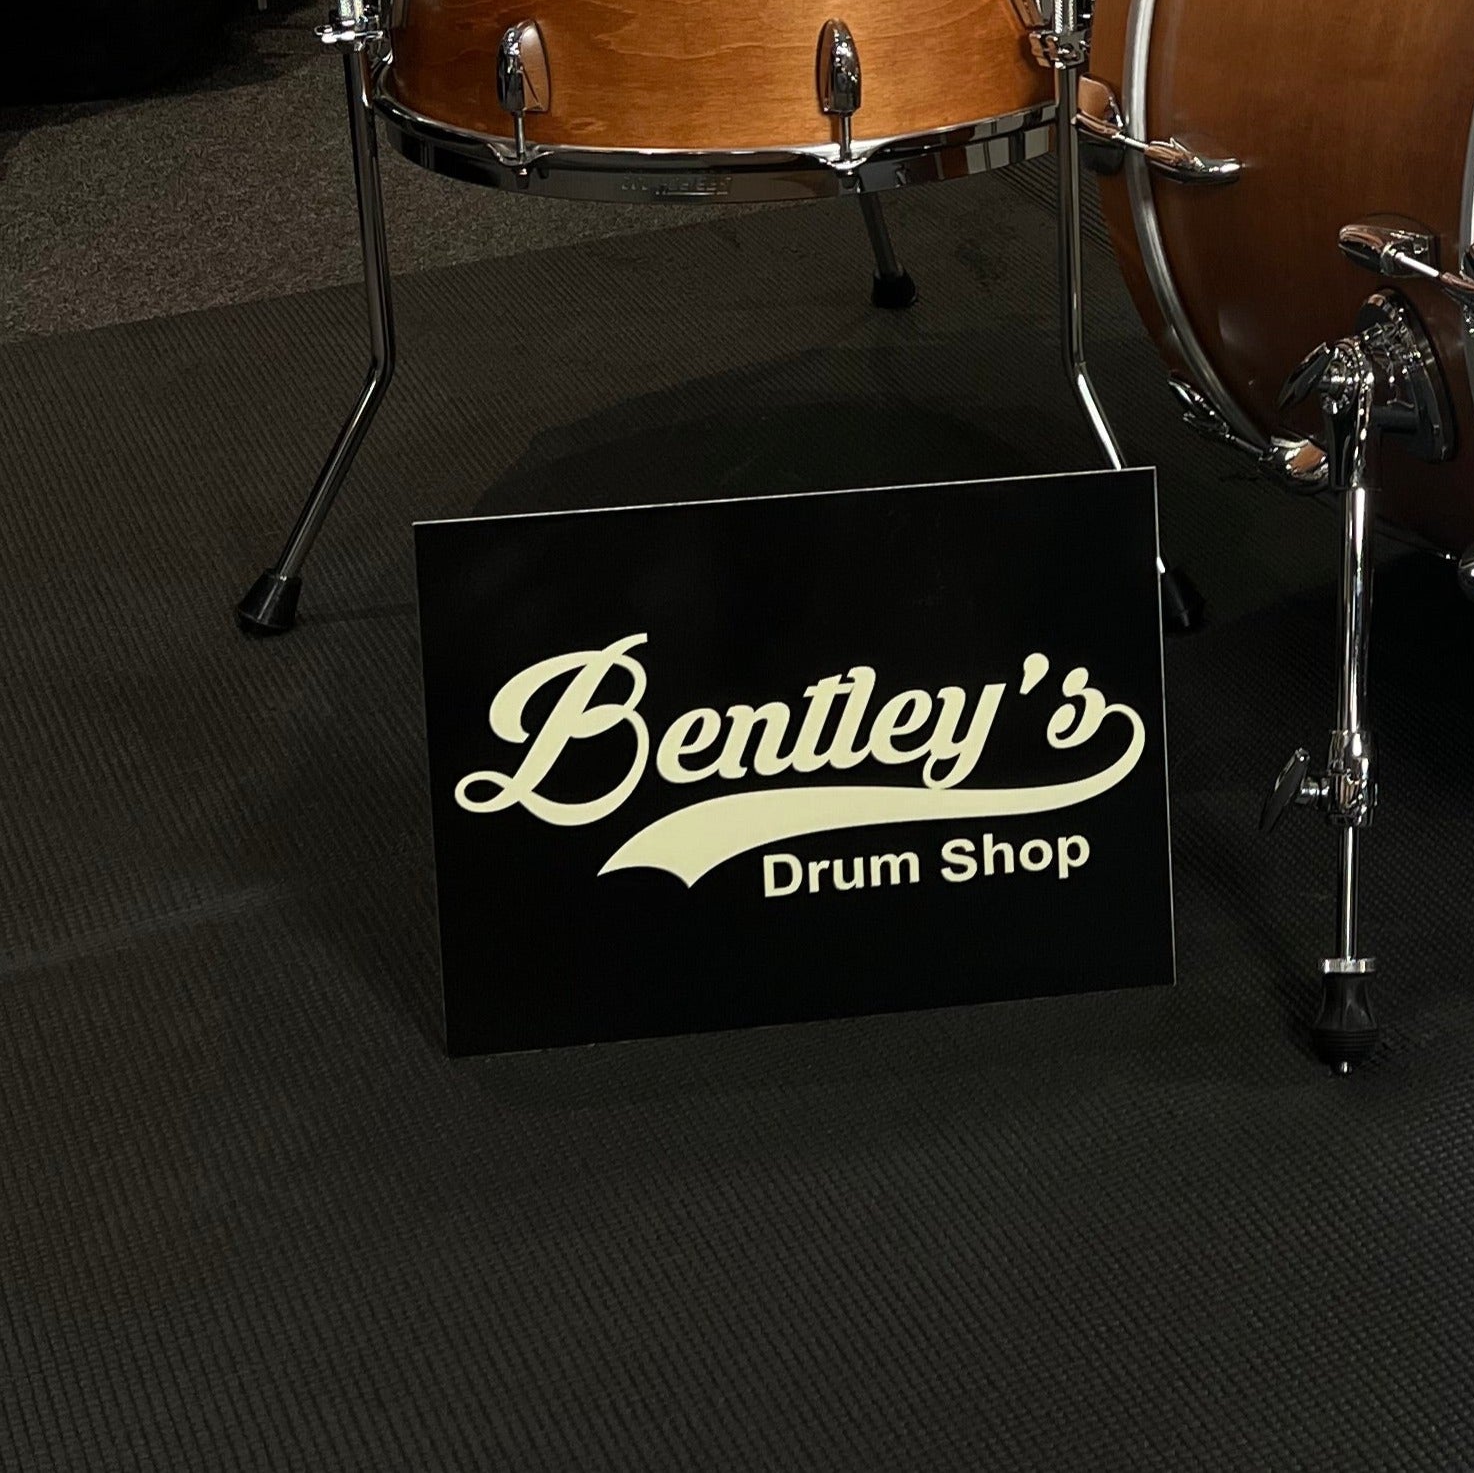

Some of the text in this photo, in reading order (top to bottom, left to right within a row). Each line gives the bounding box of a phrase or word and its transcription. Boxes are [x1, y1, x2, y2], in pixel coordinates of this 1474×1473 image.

[455, 632, 1146, 828] Bentley's
[762, 832, 1091, 899] Drum Shop
